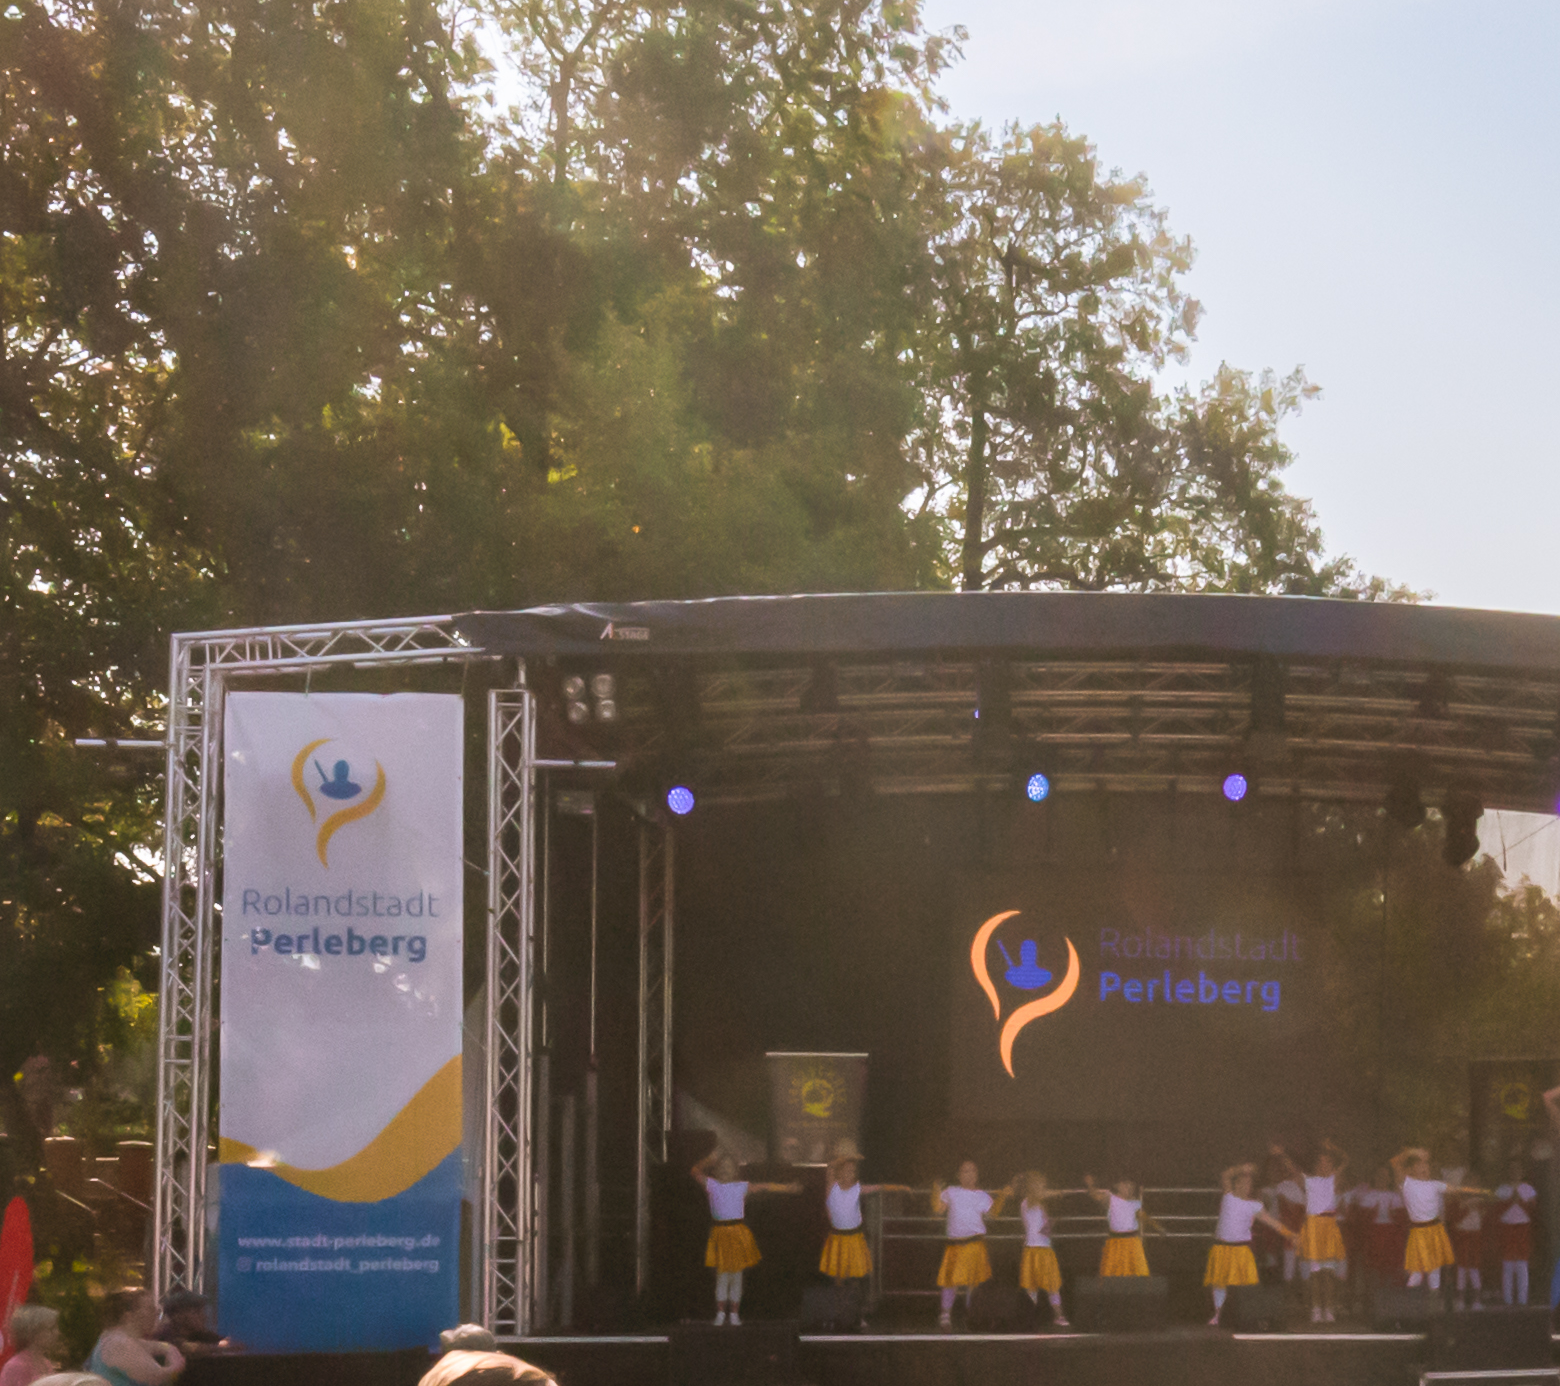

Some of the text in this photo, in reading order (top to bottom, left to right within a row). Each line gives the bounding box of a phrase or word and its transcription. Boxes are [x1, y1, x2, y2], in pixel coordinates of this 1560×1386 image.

[242, 886, 441, 918] Rolandstadt
[250, 927, 428, 963] Perleberg
[1100, 926, 1302, 961] Rolandstadt
[1100, 970, 1280, 1011] Perleberg
[238, 1234, 440, 1251] www.stadt-perleberg.de
[256, 1258, 440, 1274] rolandstadt_perleberg
